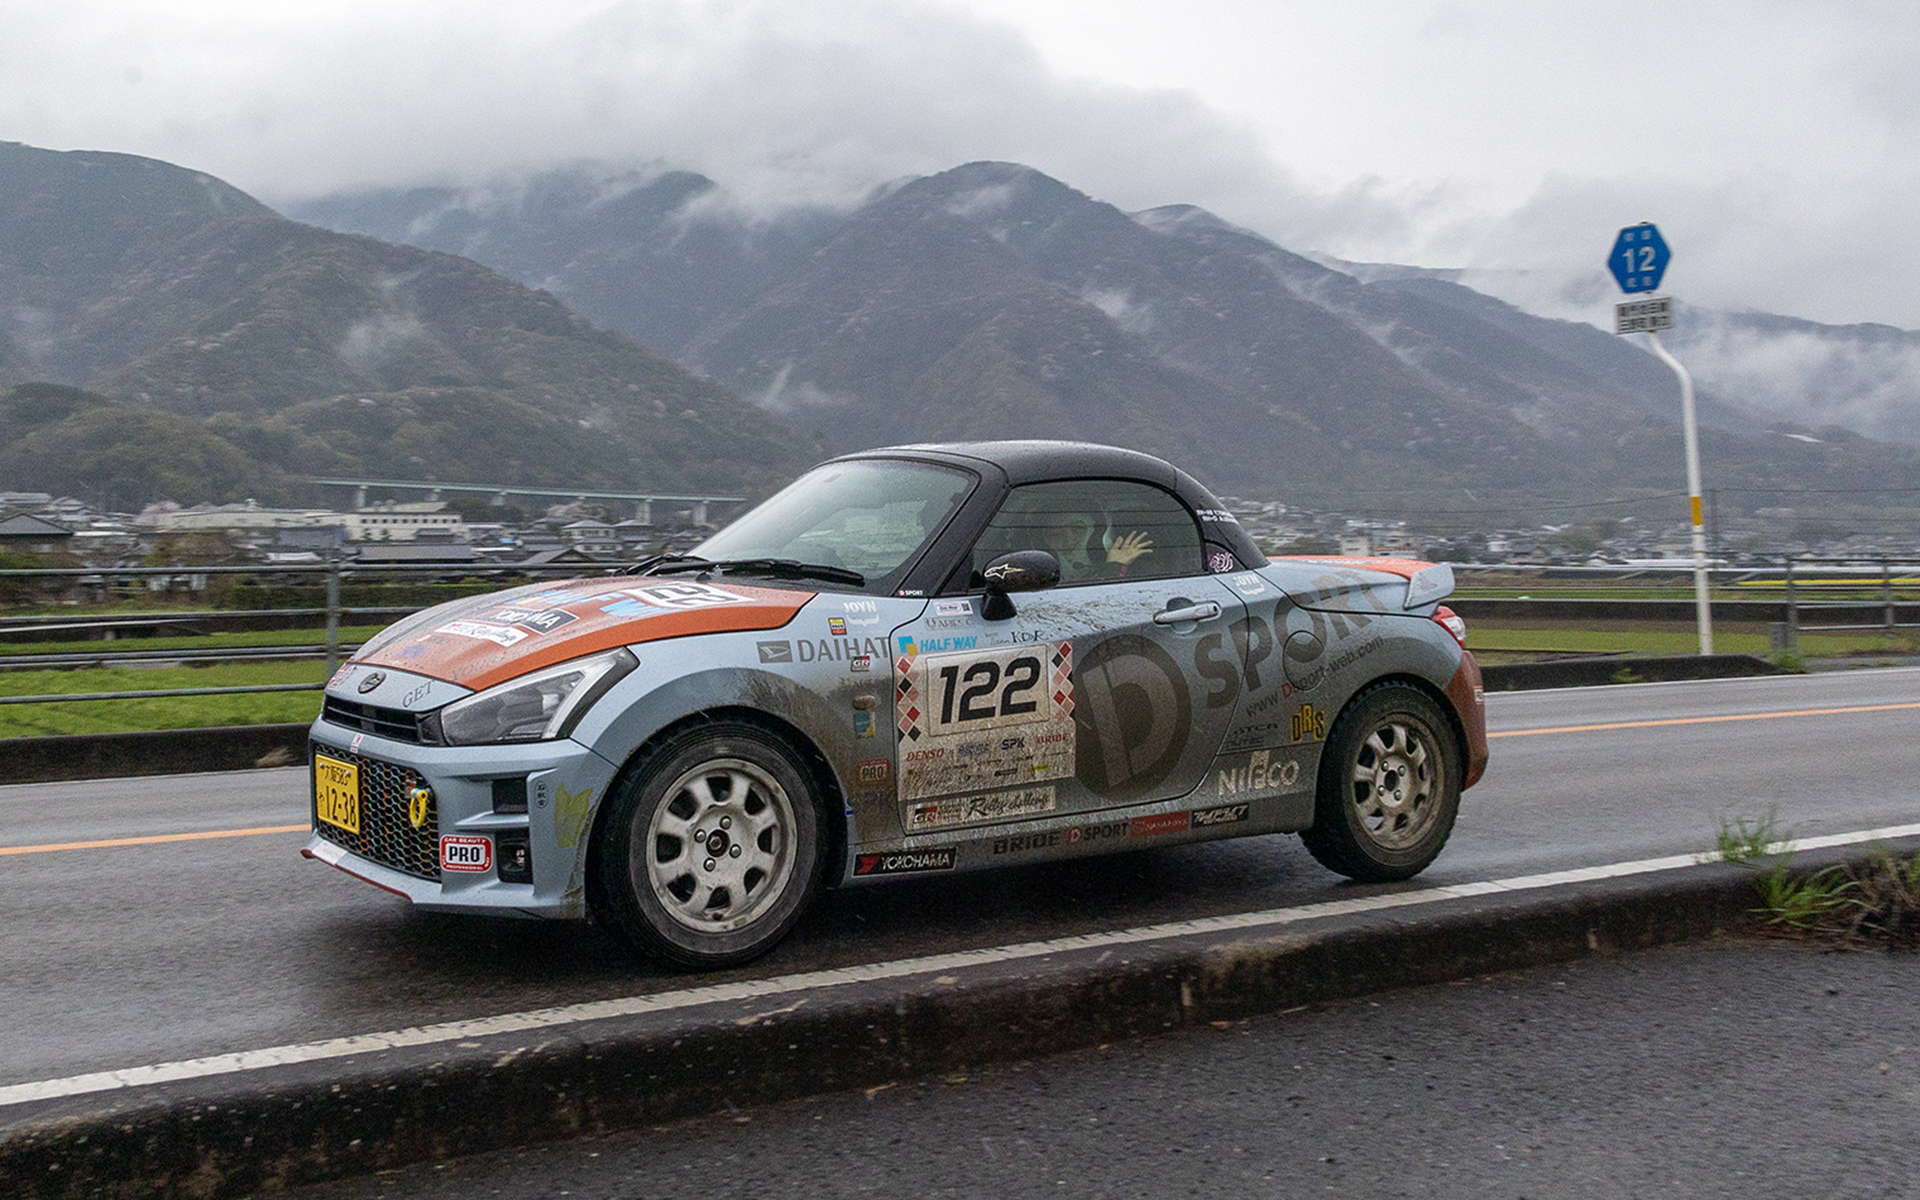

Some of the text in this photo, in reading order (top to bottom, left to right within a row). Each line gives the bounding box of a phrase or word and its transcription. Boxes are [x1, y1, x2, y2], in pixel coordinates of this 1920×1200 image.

[1622, 246, 1656, 273] 12
[843, 601, 878, 613] JOYN
[920, 635, 978, 653] HALF WAY
[1193, 569, 1389, 709] SPORT
[403, 680, 435, 708] GET
[939, 655, 1042, 726] 122
[1291, 703, 1326, 743] DRS
[1002, 736, 1026, 750] SPK
[906, 748, 945, 762] DENSO
[860, 765, 885, 780] PRO
[326, 784, 357, 828] 12-38
[1084, 822, 1131, 841] SPORT
[993, 830, 1060, 855] BRIDE
[449, 845, 480, 862] PRO
[881, 852, 950, 870] YOKOHAMA
